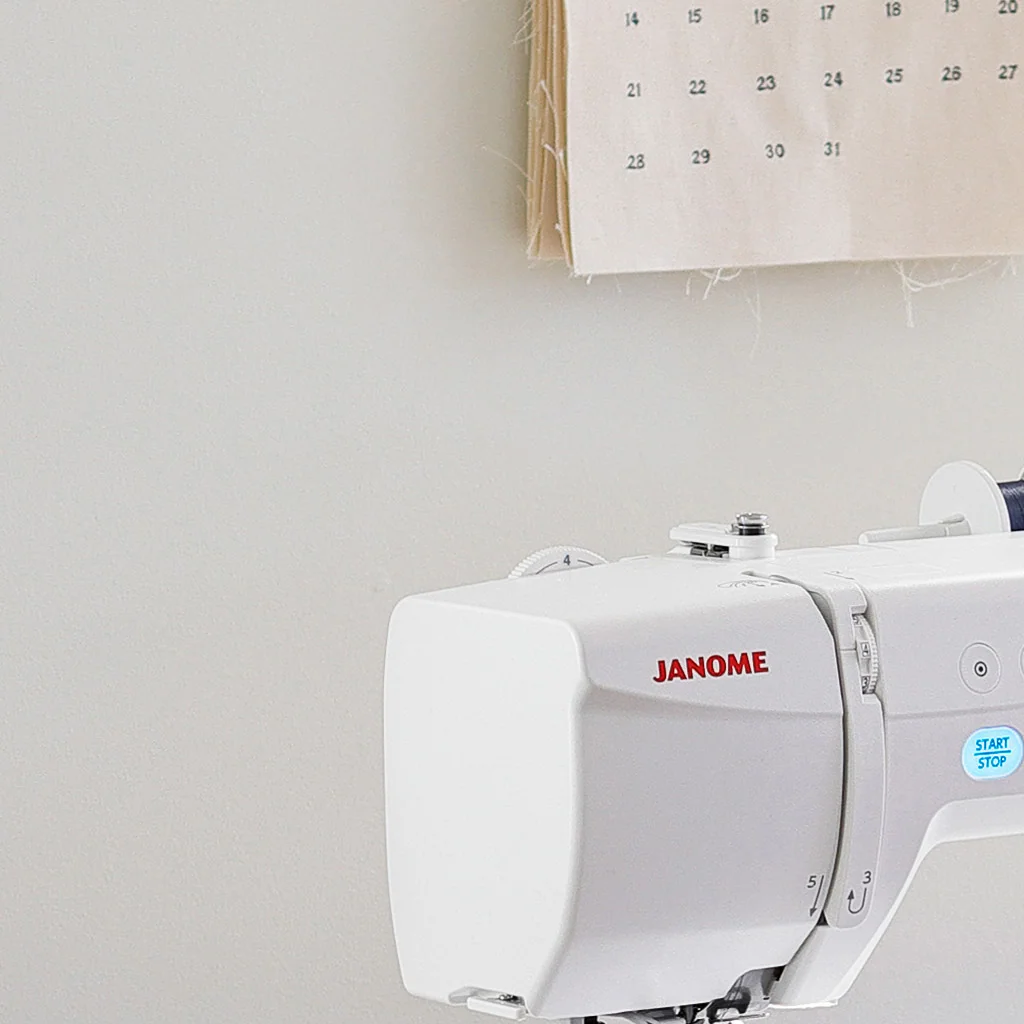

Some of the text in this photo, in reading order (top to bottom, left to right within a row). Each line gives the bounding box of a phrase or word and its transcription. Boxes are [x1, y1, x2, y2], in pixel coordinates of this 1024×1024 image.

[625, 0, 1018, 27] 14 15 16 17 18 19 20
[627, 65, 1018, 98] 21 22 23 24 25 26 27
[626, 142, 840, 170] 28 29 30 31
[563, 554, 571, 567] 4
[653, 650, 769, 683] JANOME
[975, 735, 1010, 752] START
[977, 754, 1007, 770] STOP
[806, 875, 818, 889] 5
[862, 870, 872, 885] 3
